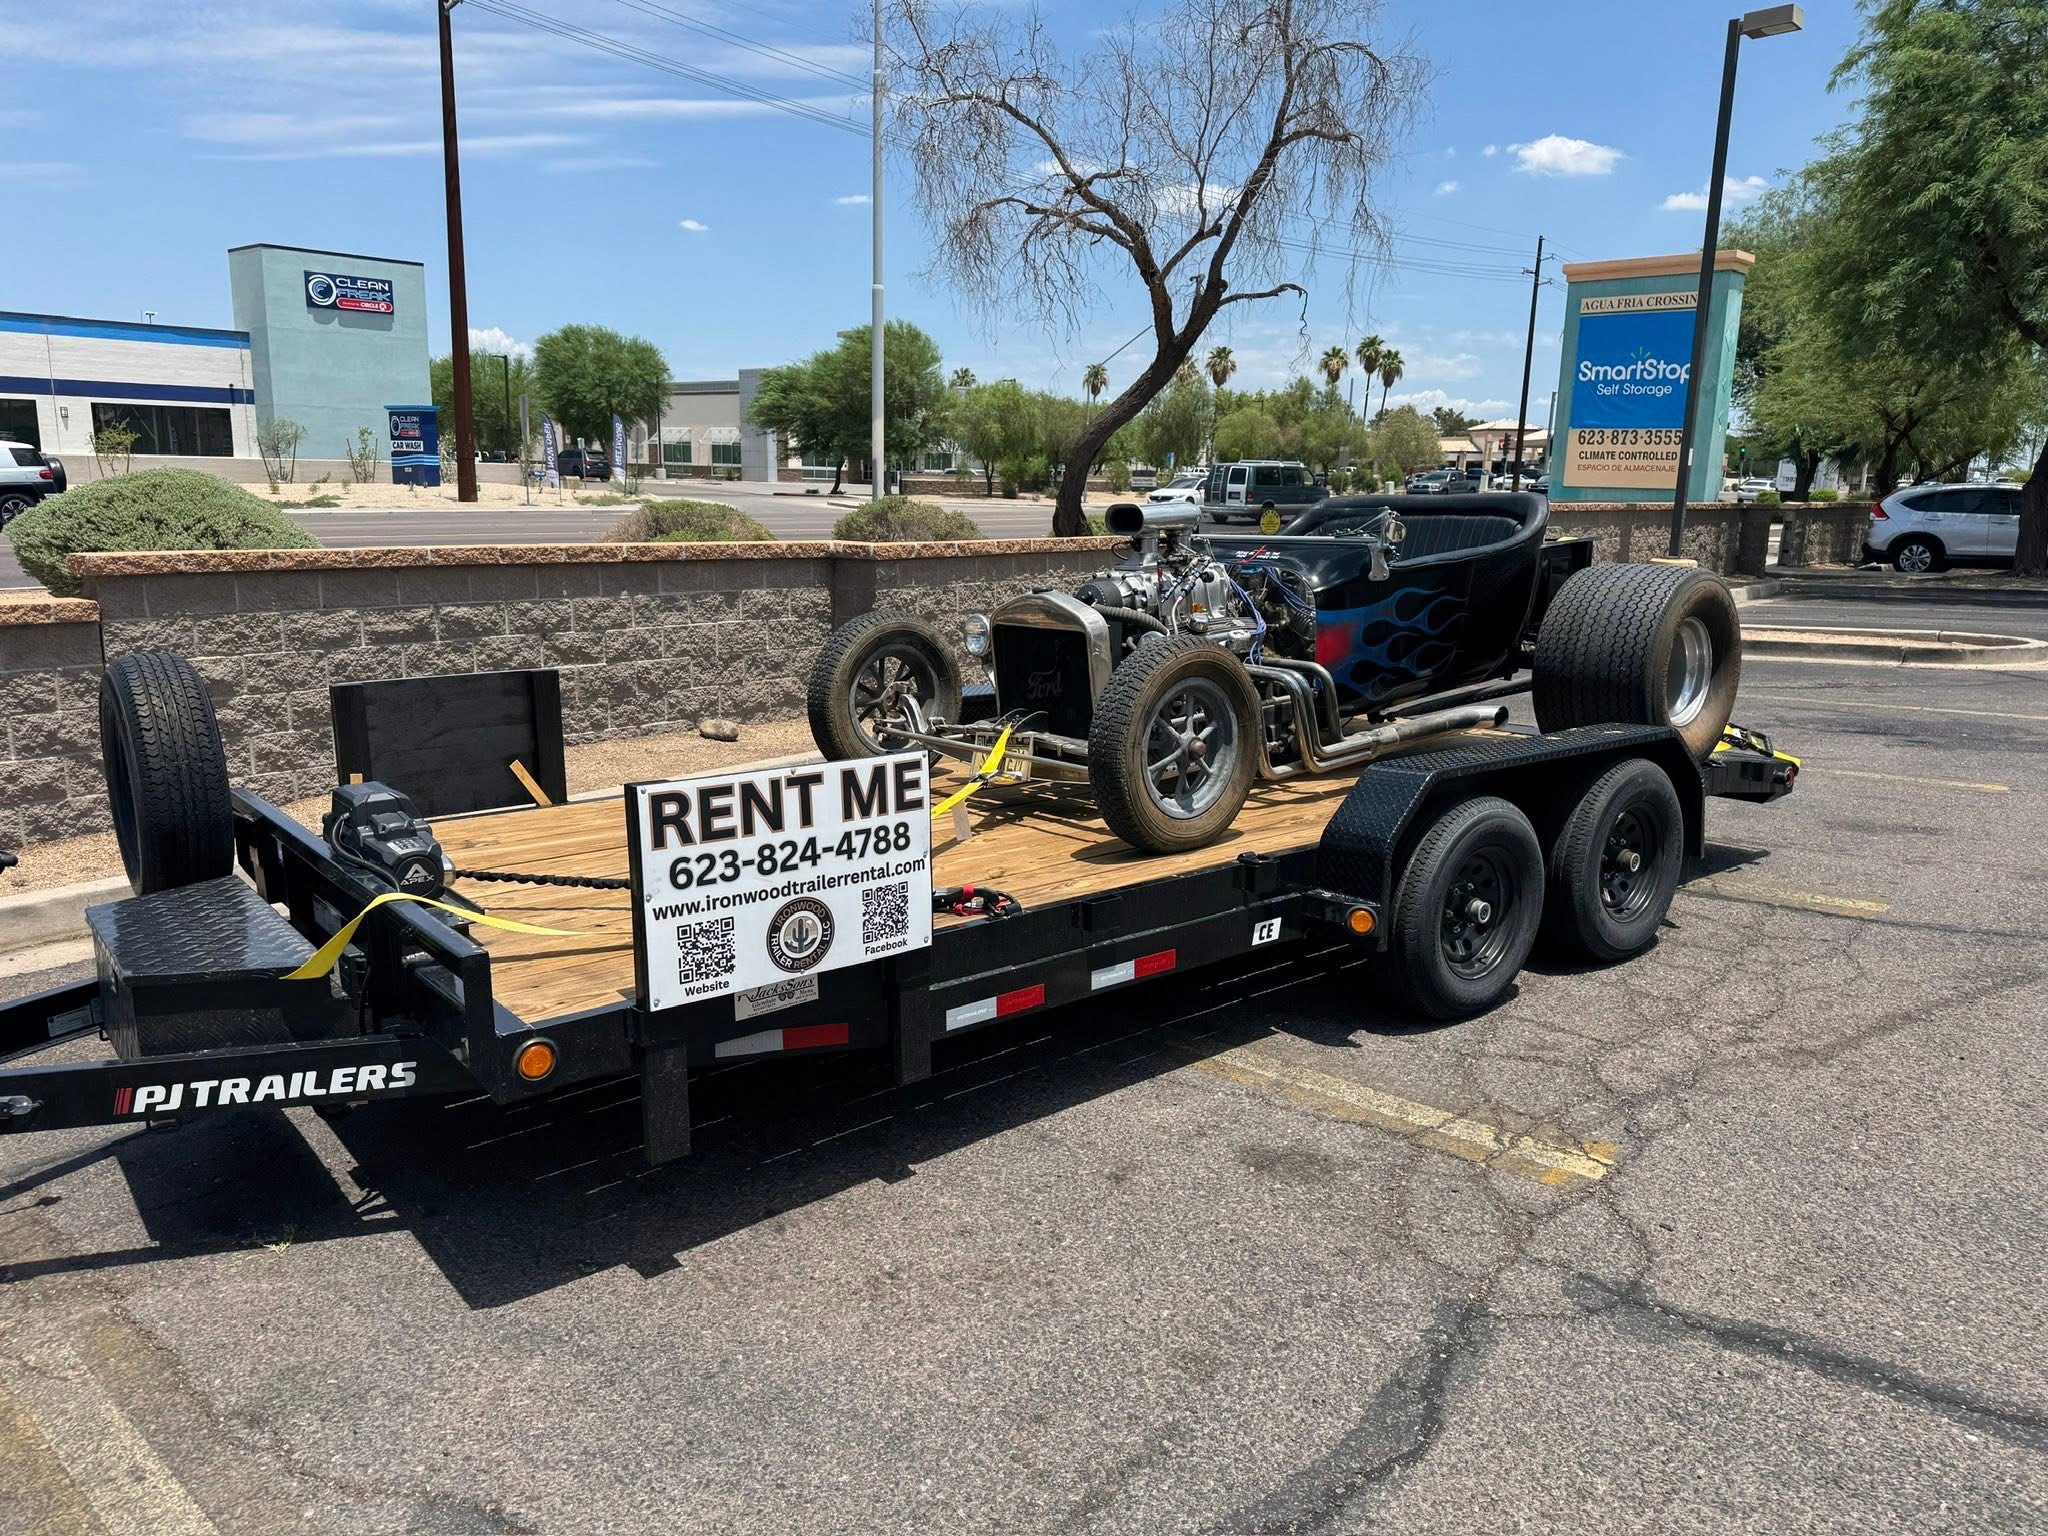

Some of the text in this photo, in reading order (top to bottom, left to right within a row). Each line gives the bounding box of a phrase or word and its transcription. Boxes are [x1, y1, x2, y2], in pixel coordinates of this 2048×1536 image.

[336, 278, 389, 291] CLEAN
[336, 288, 391, 301] FREAK
[1583, 294, 1698, 311] AGUA FRIA CROSSIN
[1578, 359, 1691, 384] SmartStop
[1597, 383, 1672, 397] Self Storage
[393, 441, 421, 449] CAR WASH
[1579, 451, 1677, 460] CLIMATE CONTROLLED
[1577, 464, 1610, 472] ESPACIO
[1624, 464, 1676, 472] ALMACENAJE
[649, 758, 925, 851] RENT ME
[669, 822, 911, 890] 623-824-4788
[400, 874, 435, 886] APEX
[653, 857, 926, 921] www.ironwoodtrailerrental.com
[775, 901, 826, 927] IRONWOOD
[822, 921, 831, 940] LLC
[1258, 922, 1274, 941] CE
[771, 931, 827, 969] TRAILER RENTAL
[865, 938, 908, 955] Facebook
[684, 979, 730, 997] Website
[133, 1061, 417, 1114] PJ TRAILERS
